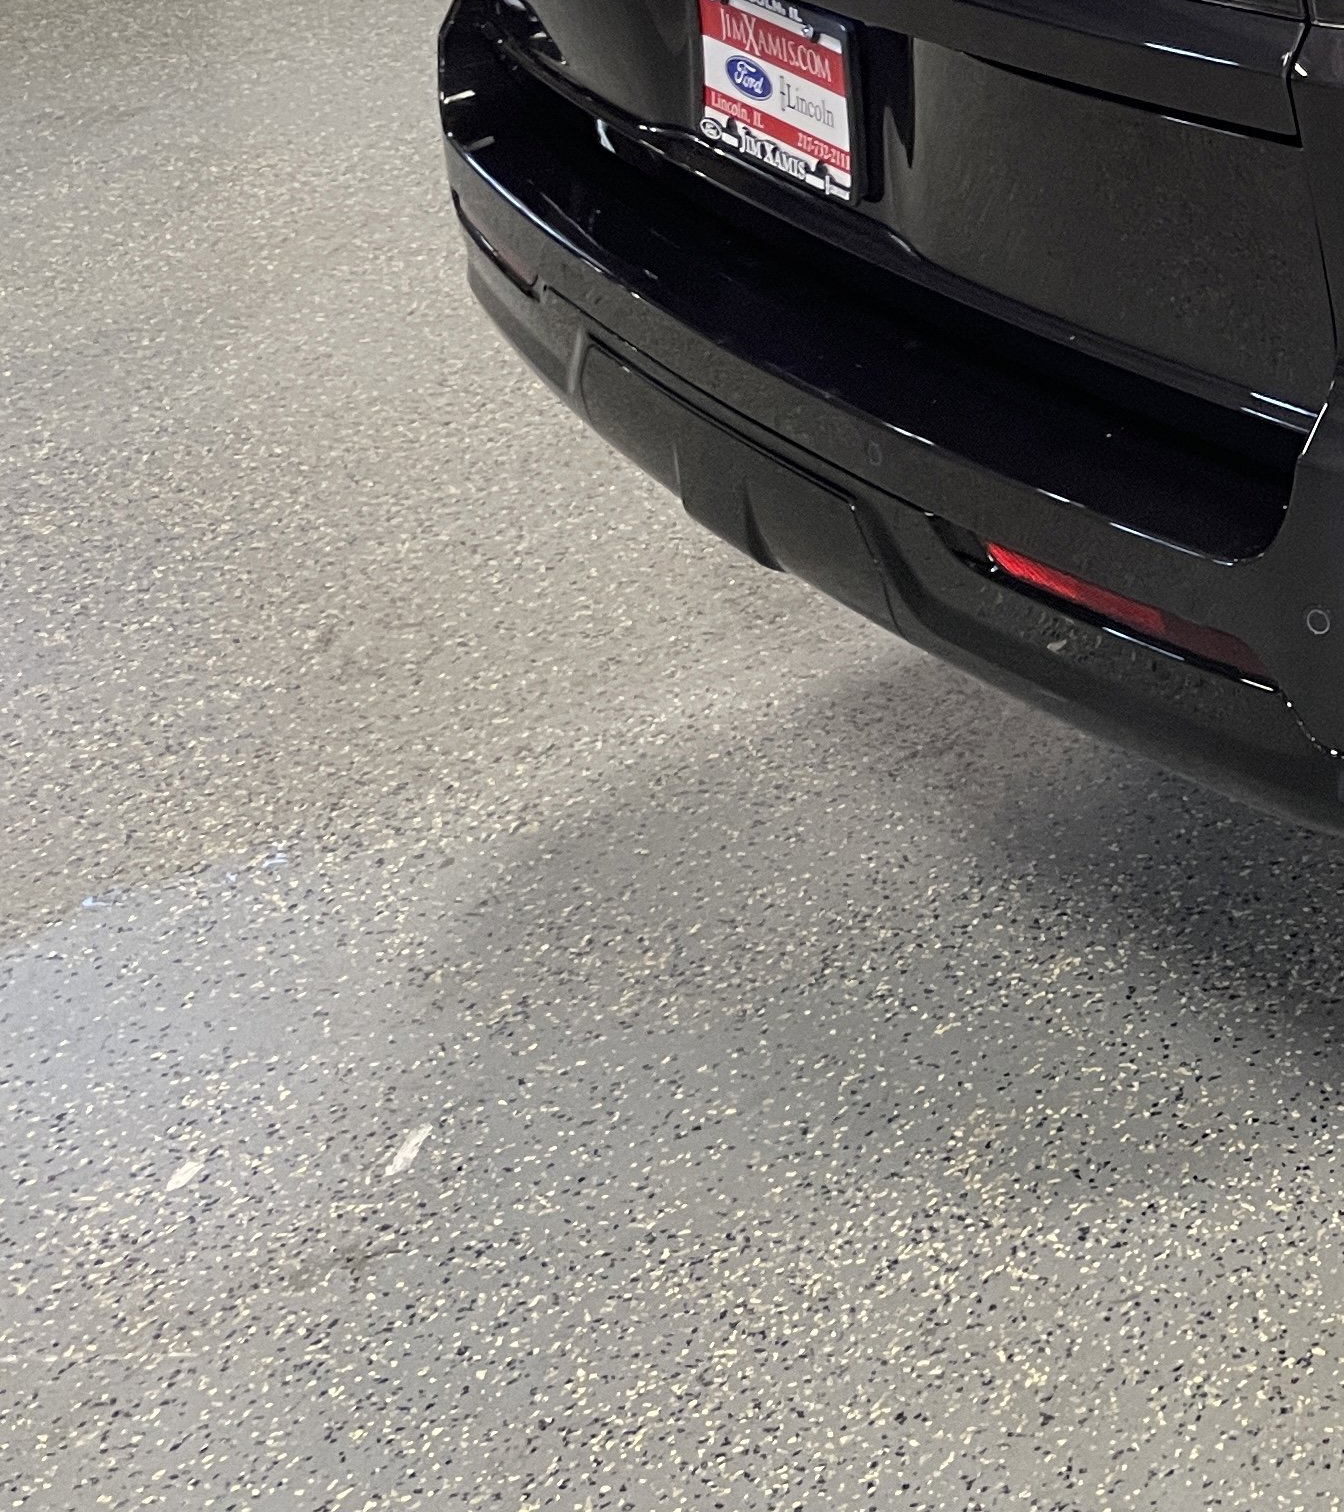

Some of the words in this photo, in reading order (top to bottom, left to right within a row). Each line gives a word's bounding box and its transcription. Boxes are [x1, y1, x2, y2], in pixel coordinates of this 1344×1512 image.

[720, 8, 832, 83] JIMXAMIS.COM
[733, 59, 764, 95] Ford
[787, 83, 835, 129] Lincoln
